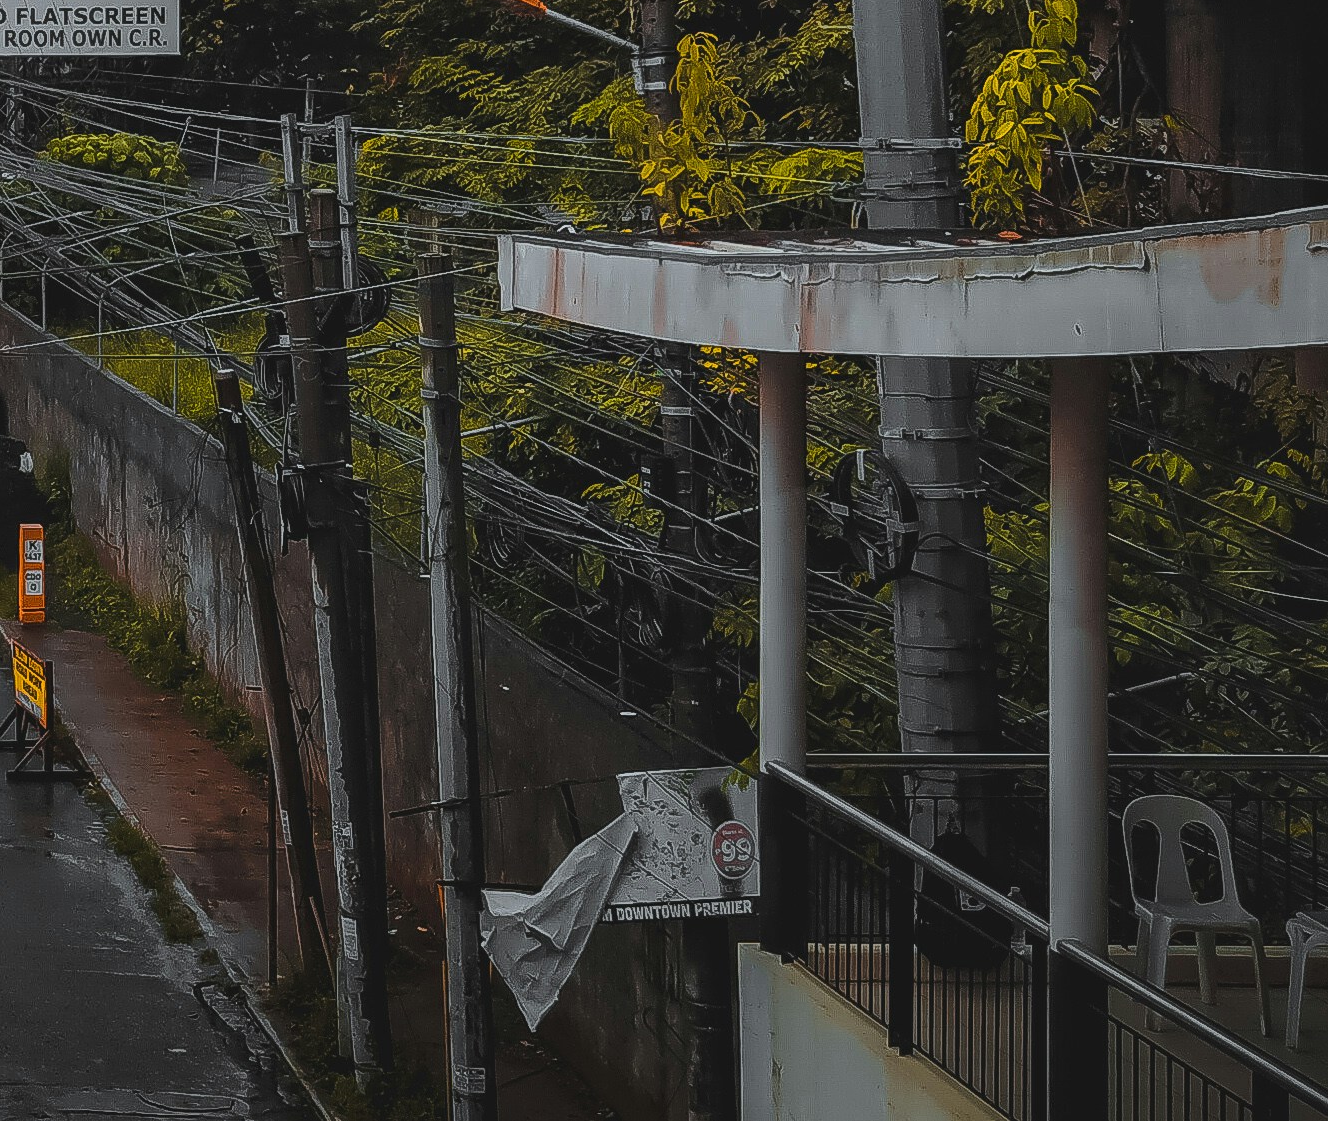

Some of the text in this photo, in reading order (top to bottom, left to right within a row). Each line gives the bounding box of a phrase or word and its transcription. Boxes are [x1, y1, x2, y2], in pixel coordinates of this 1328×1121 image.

[16, 6, 167, 26] FLATSCREEN
[4, 29, 65, 48] ROOM
[72, 29, 122, 48] OWN
[129, 29, 168, 48] C.R.
[28, 540, 38, 551] K
[616, 903, 691, 921] DOWNTOWN
[694, 899, 753, 917] PREMIER
